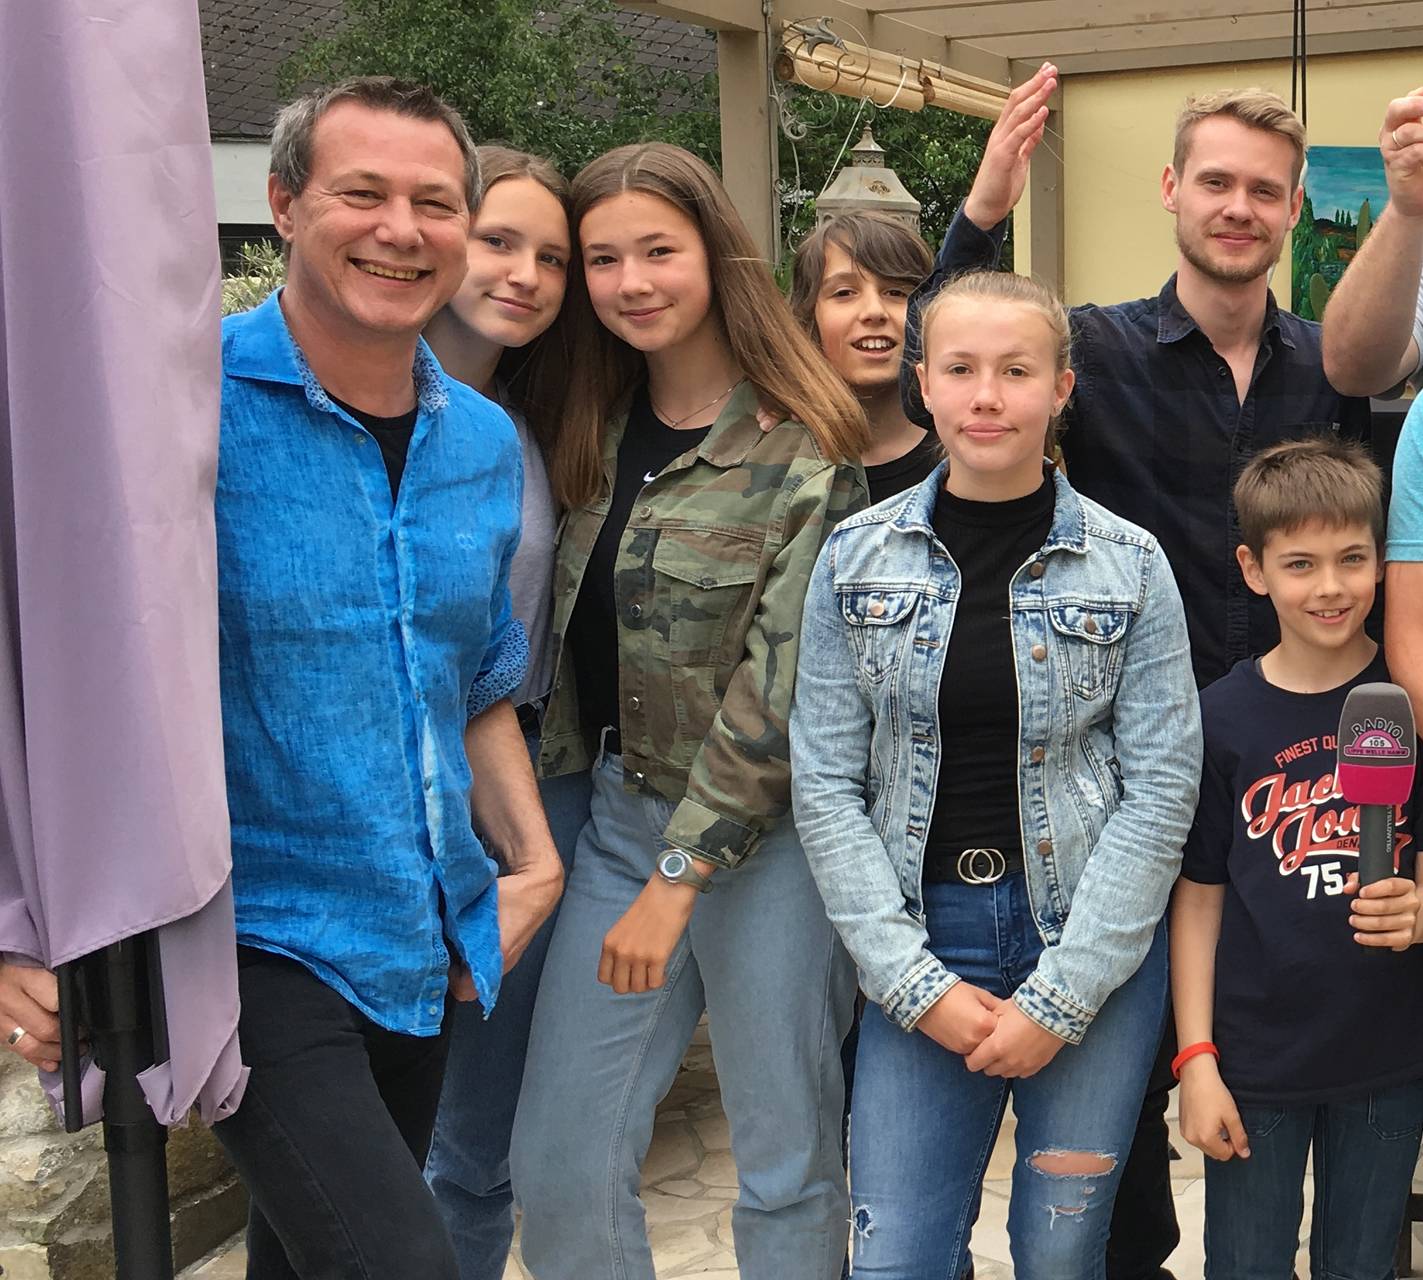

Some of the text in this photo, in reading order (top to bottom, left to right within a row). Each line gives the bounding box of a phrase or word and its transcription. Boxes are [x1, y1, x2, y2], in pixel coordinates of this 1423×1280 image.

[1351, 718, 1403, 739] RADIO
[1274, 735, 1338, 768] FINEST QU
[1336, 836, 1360, 848] DEN
[1301, 861, 1344, 899] 75
